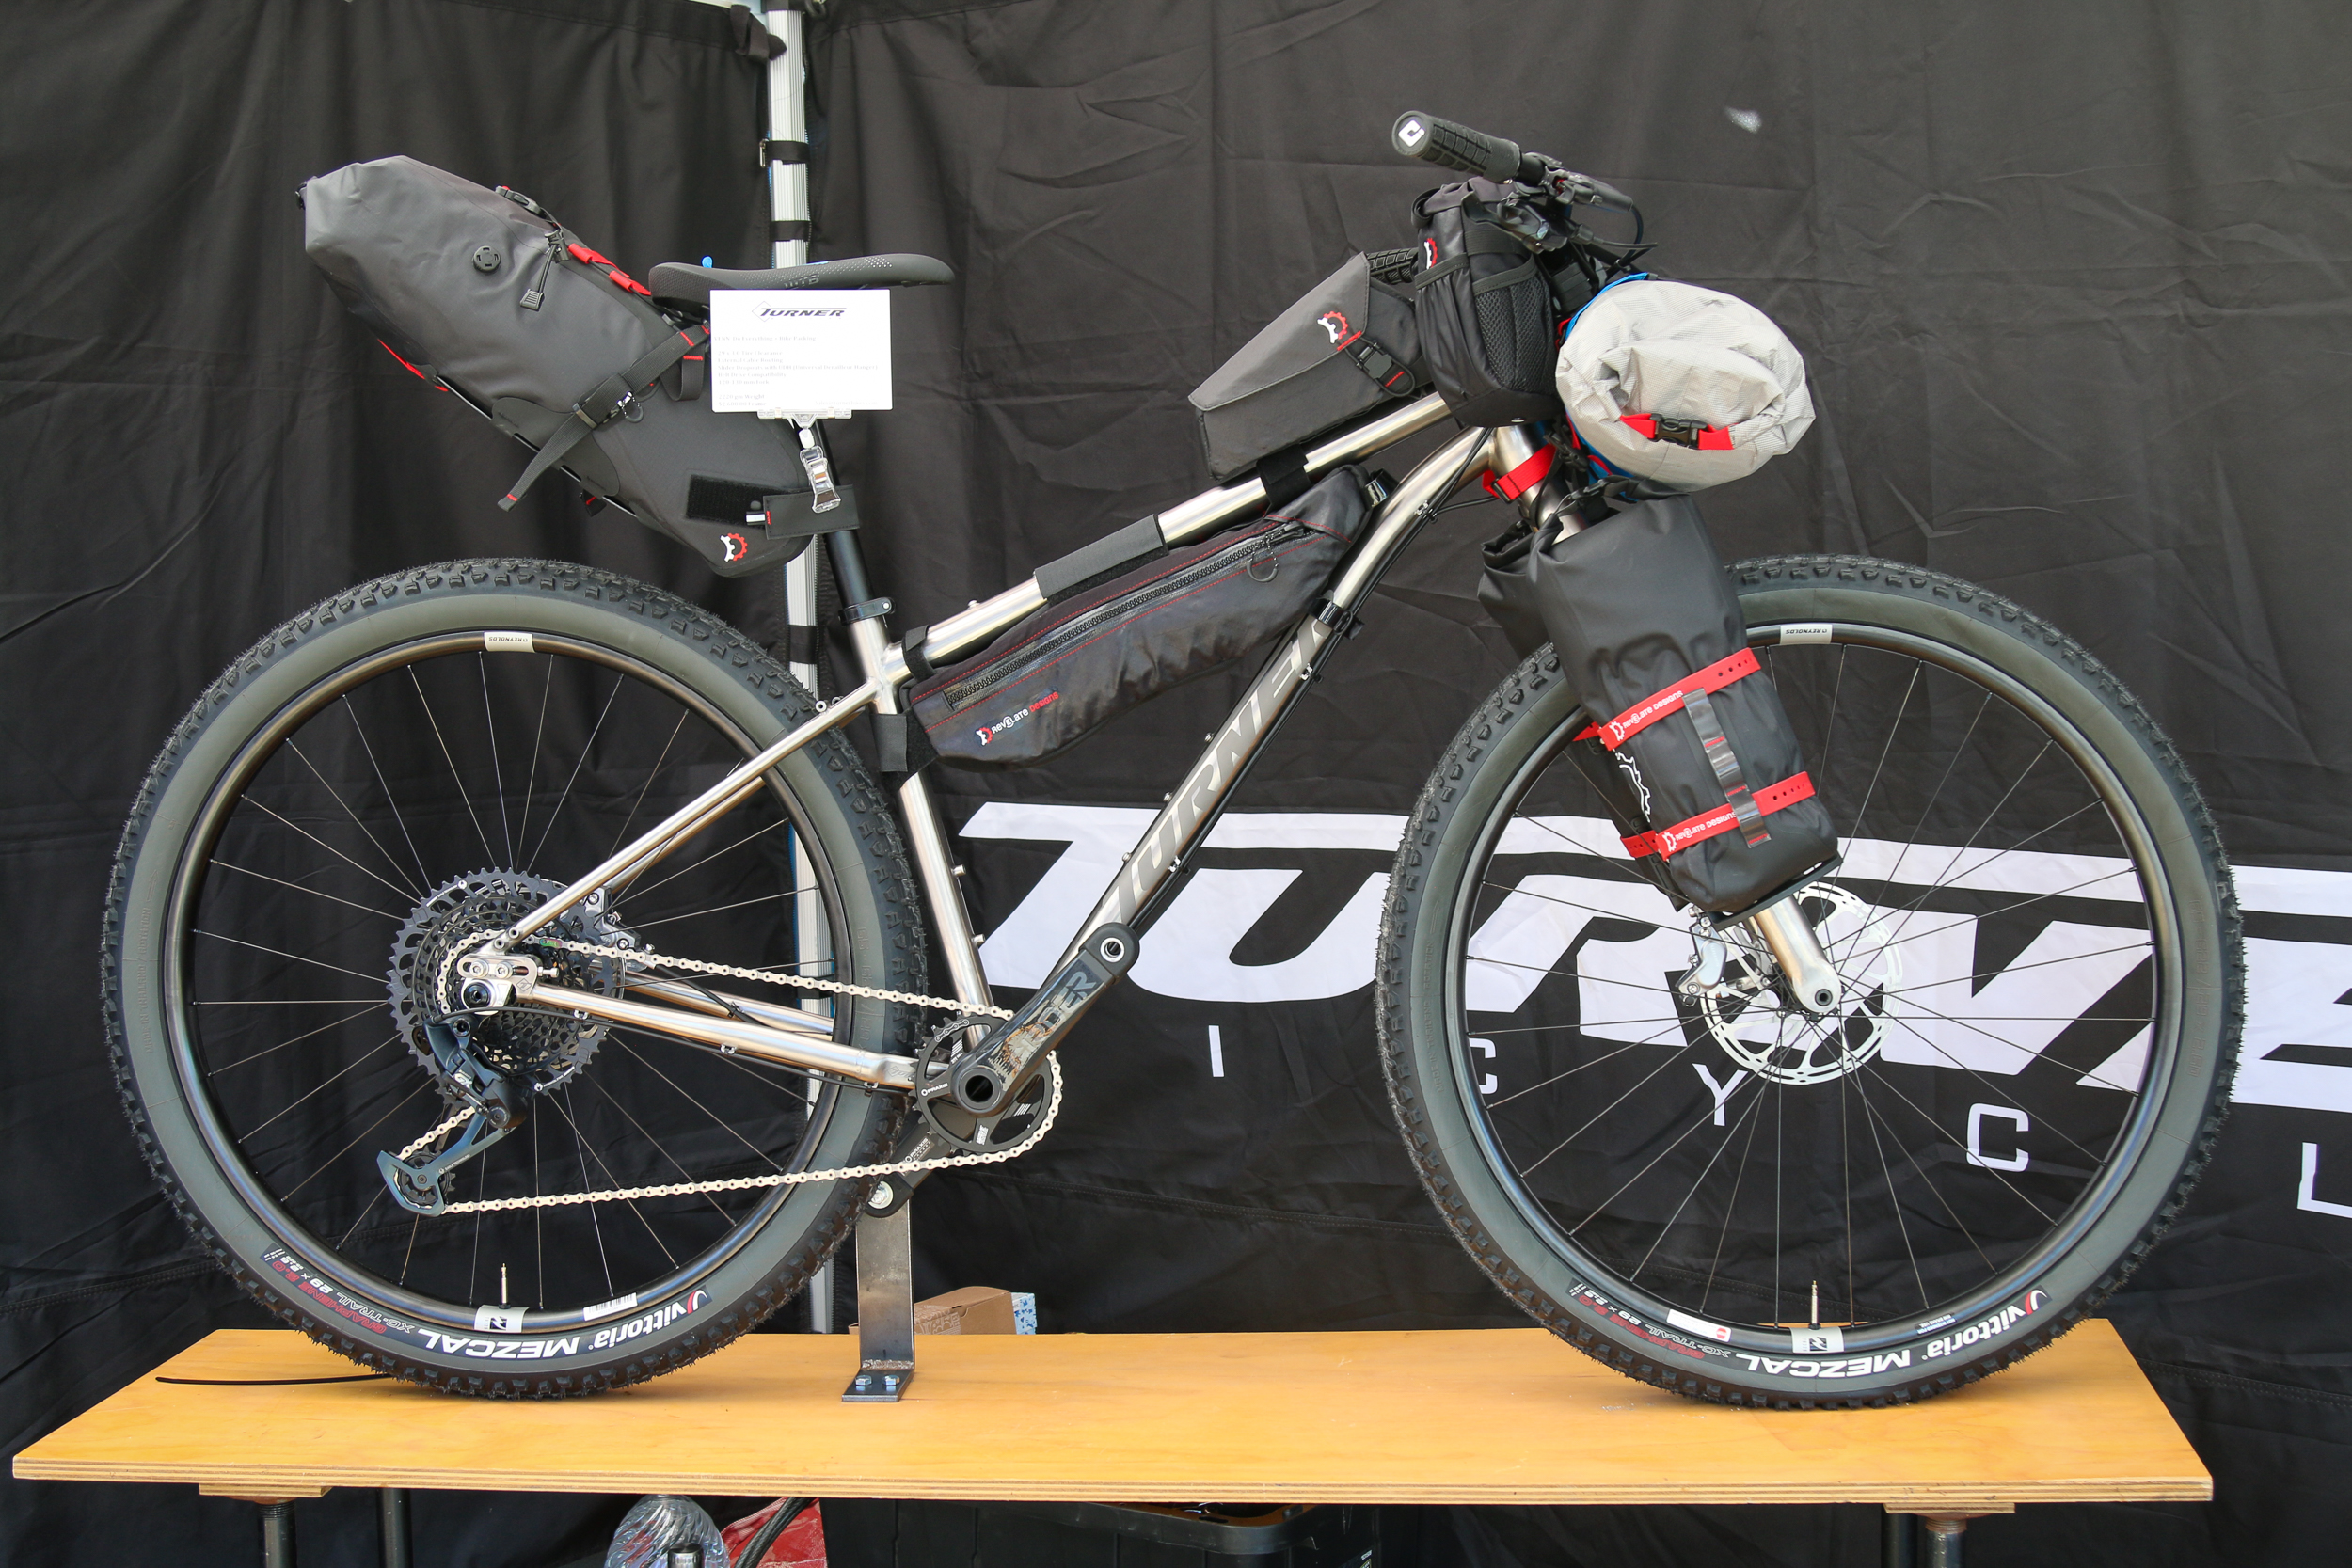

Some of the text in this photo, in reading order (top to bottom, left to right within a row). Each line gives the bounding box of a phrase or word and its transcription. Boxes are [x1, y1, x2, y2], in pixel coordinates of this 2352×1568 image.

[760, 307, 847, 317] TURNER
[310, 1277, 333, 1294] 29
[297, 1281, 388, 1334] GRAPHENE
[1618, 1309, 1642, 1325] 29
[418, 1328, 580, 1362] MEZCAL
[1736, 1349, 1910, 1379] MEZCAL
